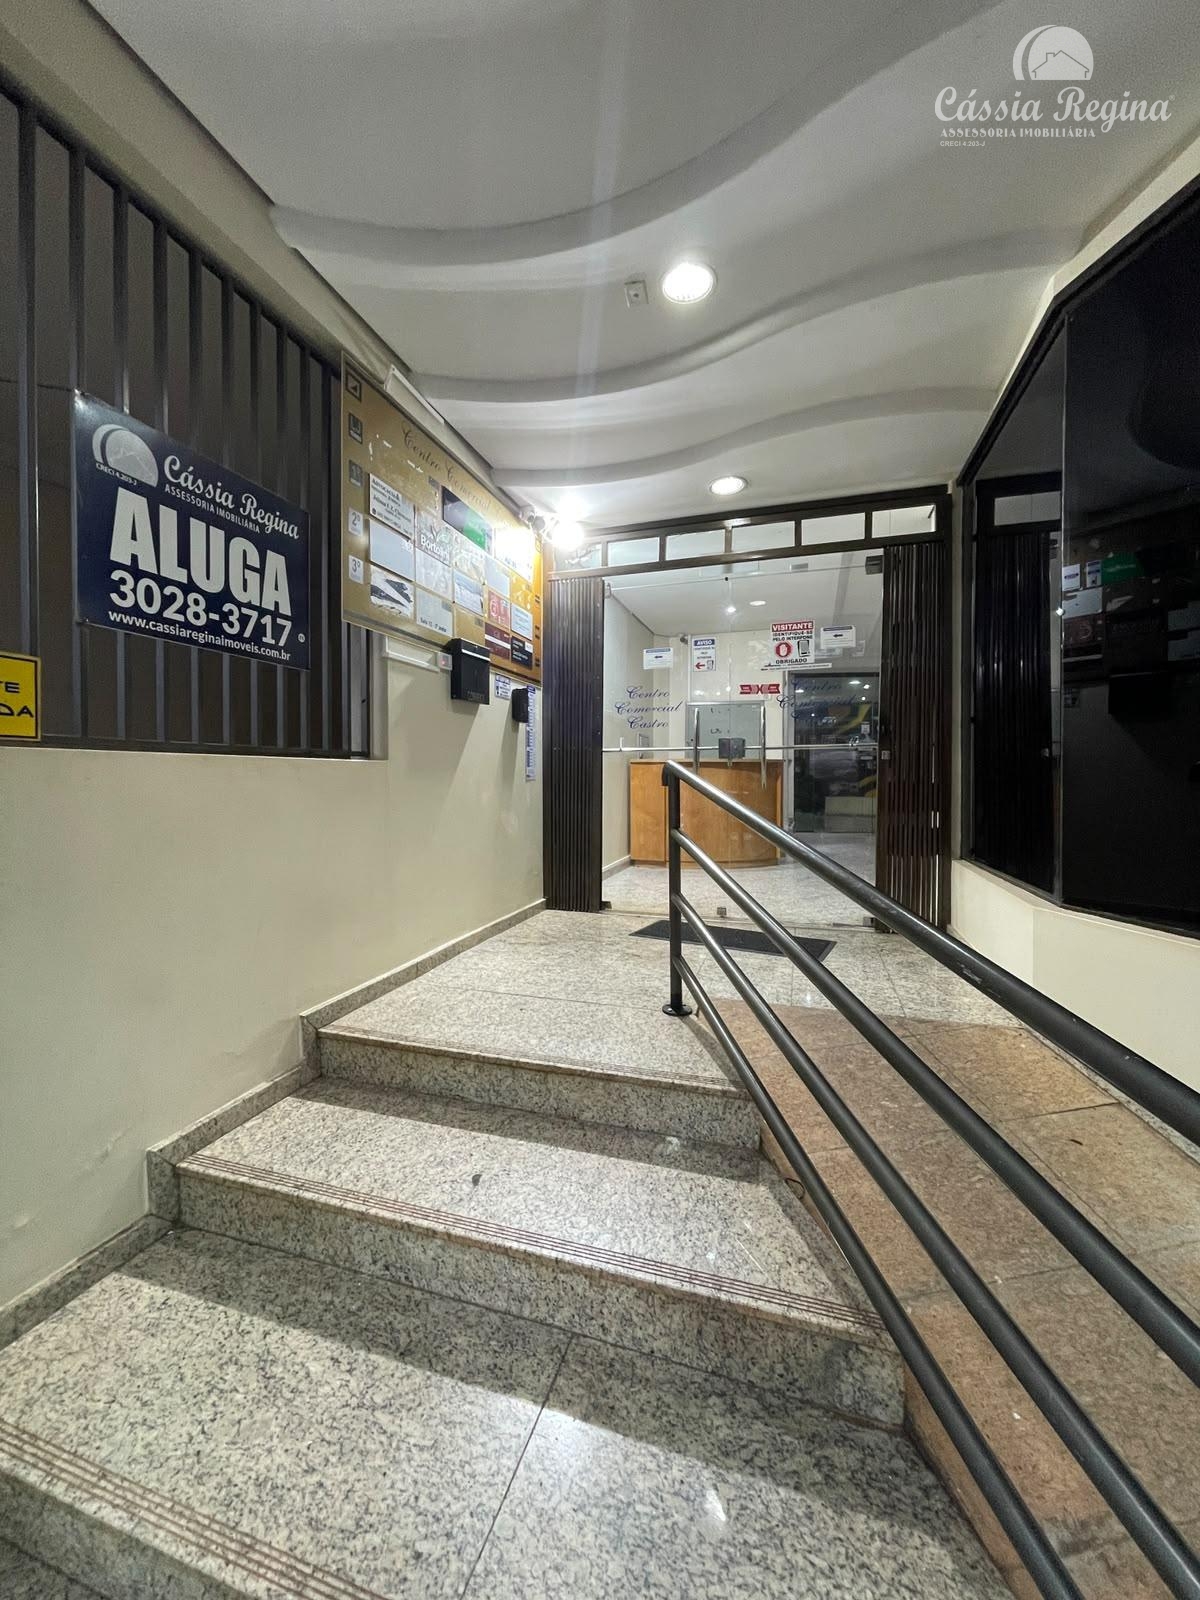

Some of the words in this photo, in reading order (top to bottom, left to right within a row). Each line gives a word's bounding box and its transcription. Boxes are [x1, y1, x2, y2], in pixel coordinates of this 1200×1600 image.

[164, 455, 235, 509] Cássia
[240, 493, 299, 540] Regina
[164, 484, 215, 515] ASSESSORIA
[109, 486, 292, 616] ALUGA
[109, 569, 292, 647] 3028-3717
[108, 610, 291, 661] www.cassiareginaimoveis.com.br
[772, 622, 813, 632] VISITANTE
[775, 657, 807, 665] OBRIGADO
[626, 685, 670, 699] Centro
[614, 700, 684, 715] Comercial
[627, 716, 669, 730] Castro
